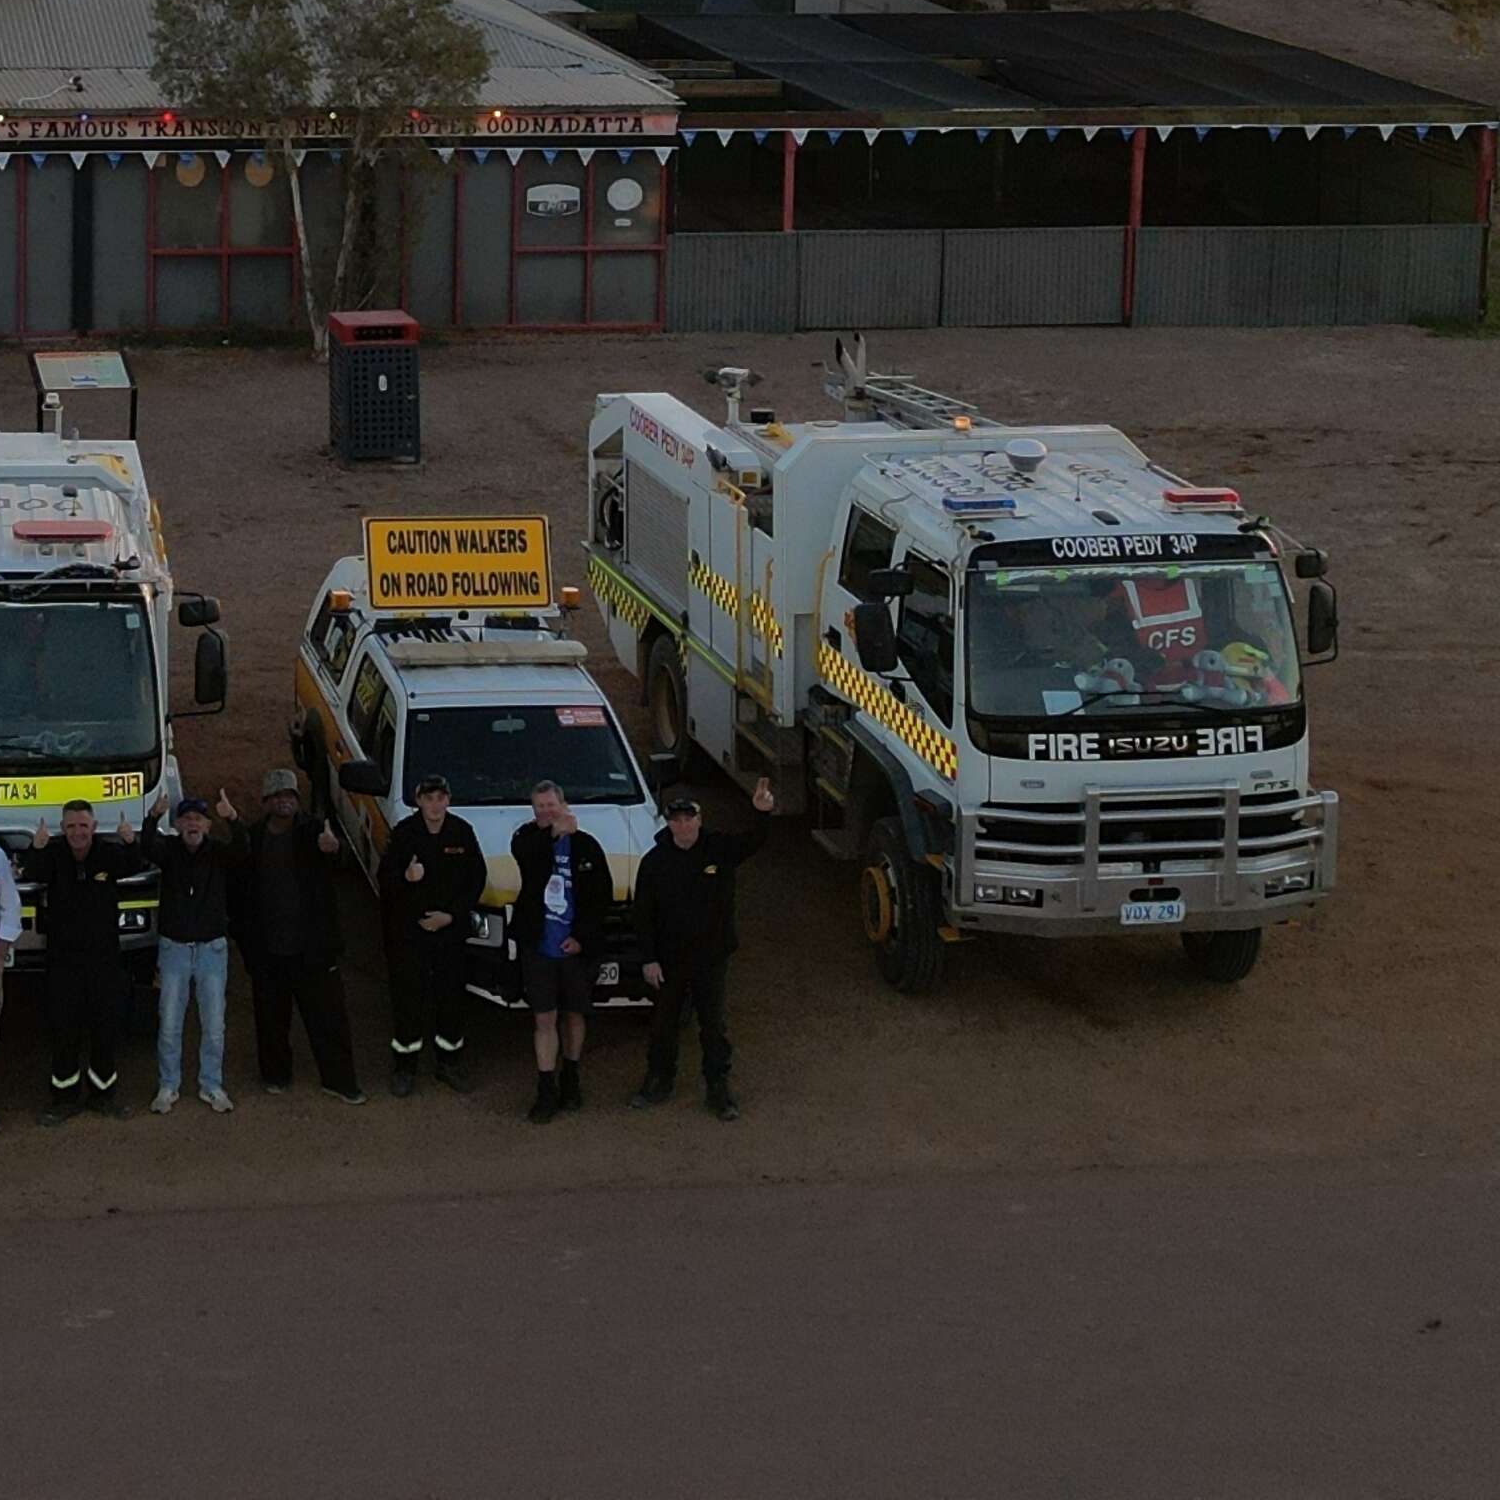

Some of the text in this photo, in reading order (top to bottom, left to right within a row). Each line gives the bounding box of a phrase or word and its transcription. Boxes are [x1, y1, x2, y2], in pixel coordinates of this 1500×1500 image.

[30, 121, 128, 139] FAMOUS
[487, 116, 645, 135] OODNADATTA
[387, 529, 528, 554] CAUTION WALKERS
[1051, 534, 1199, 558] COOBER PEDY 34P
[380, 571, 540, 597] ON ROAD FOLLOWING
[1148, 626, 1197, 650] CFS
[1028, 733, 1188, 760] FIRE ISUZU
[23, 784, 37, 800] 34
[1254, 780, 1290, 791] FTS
